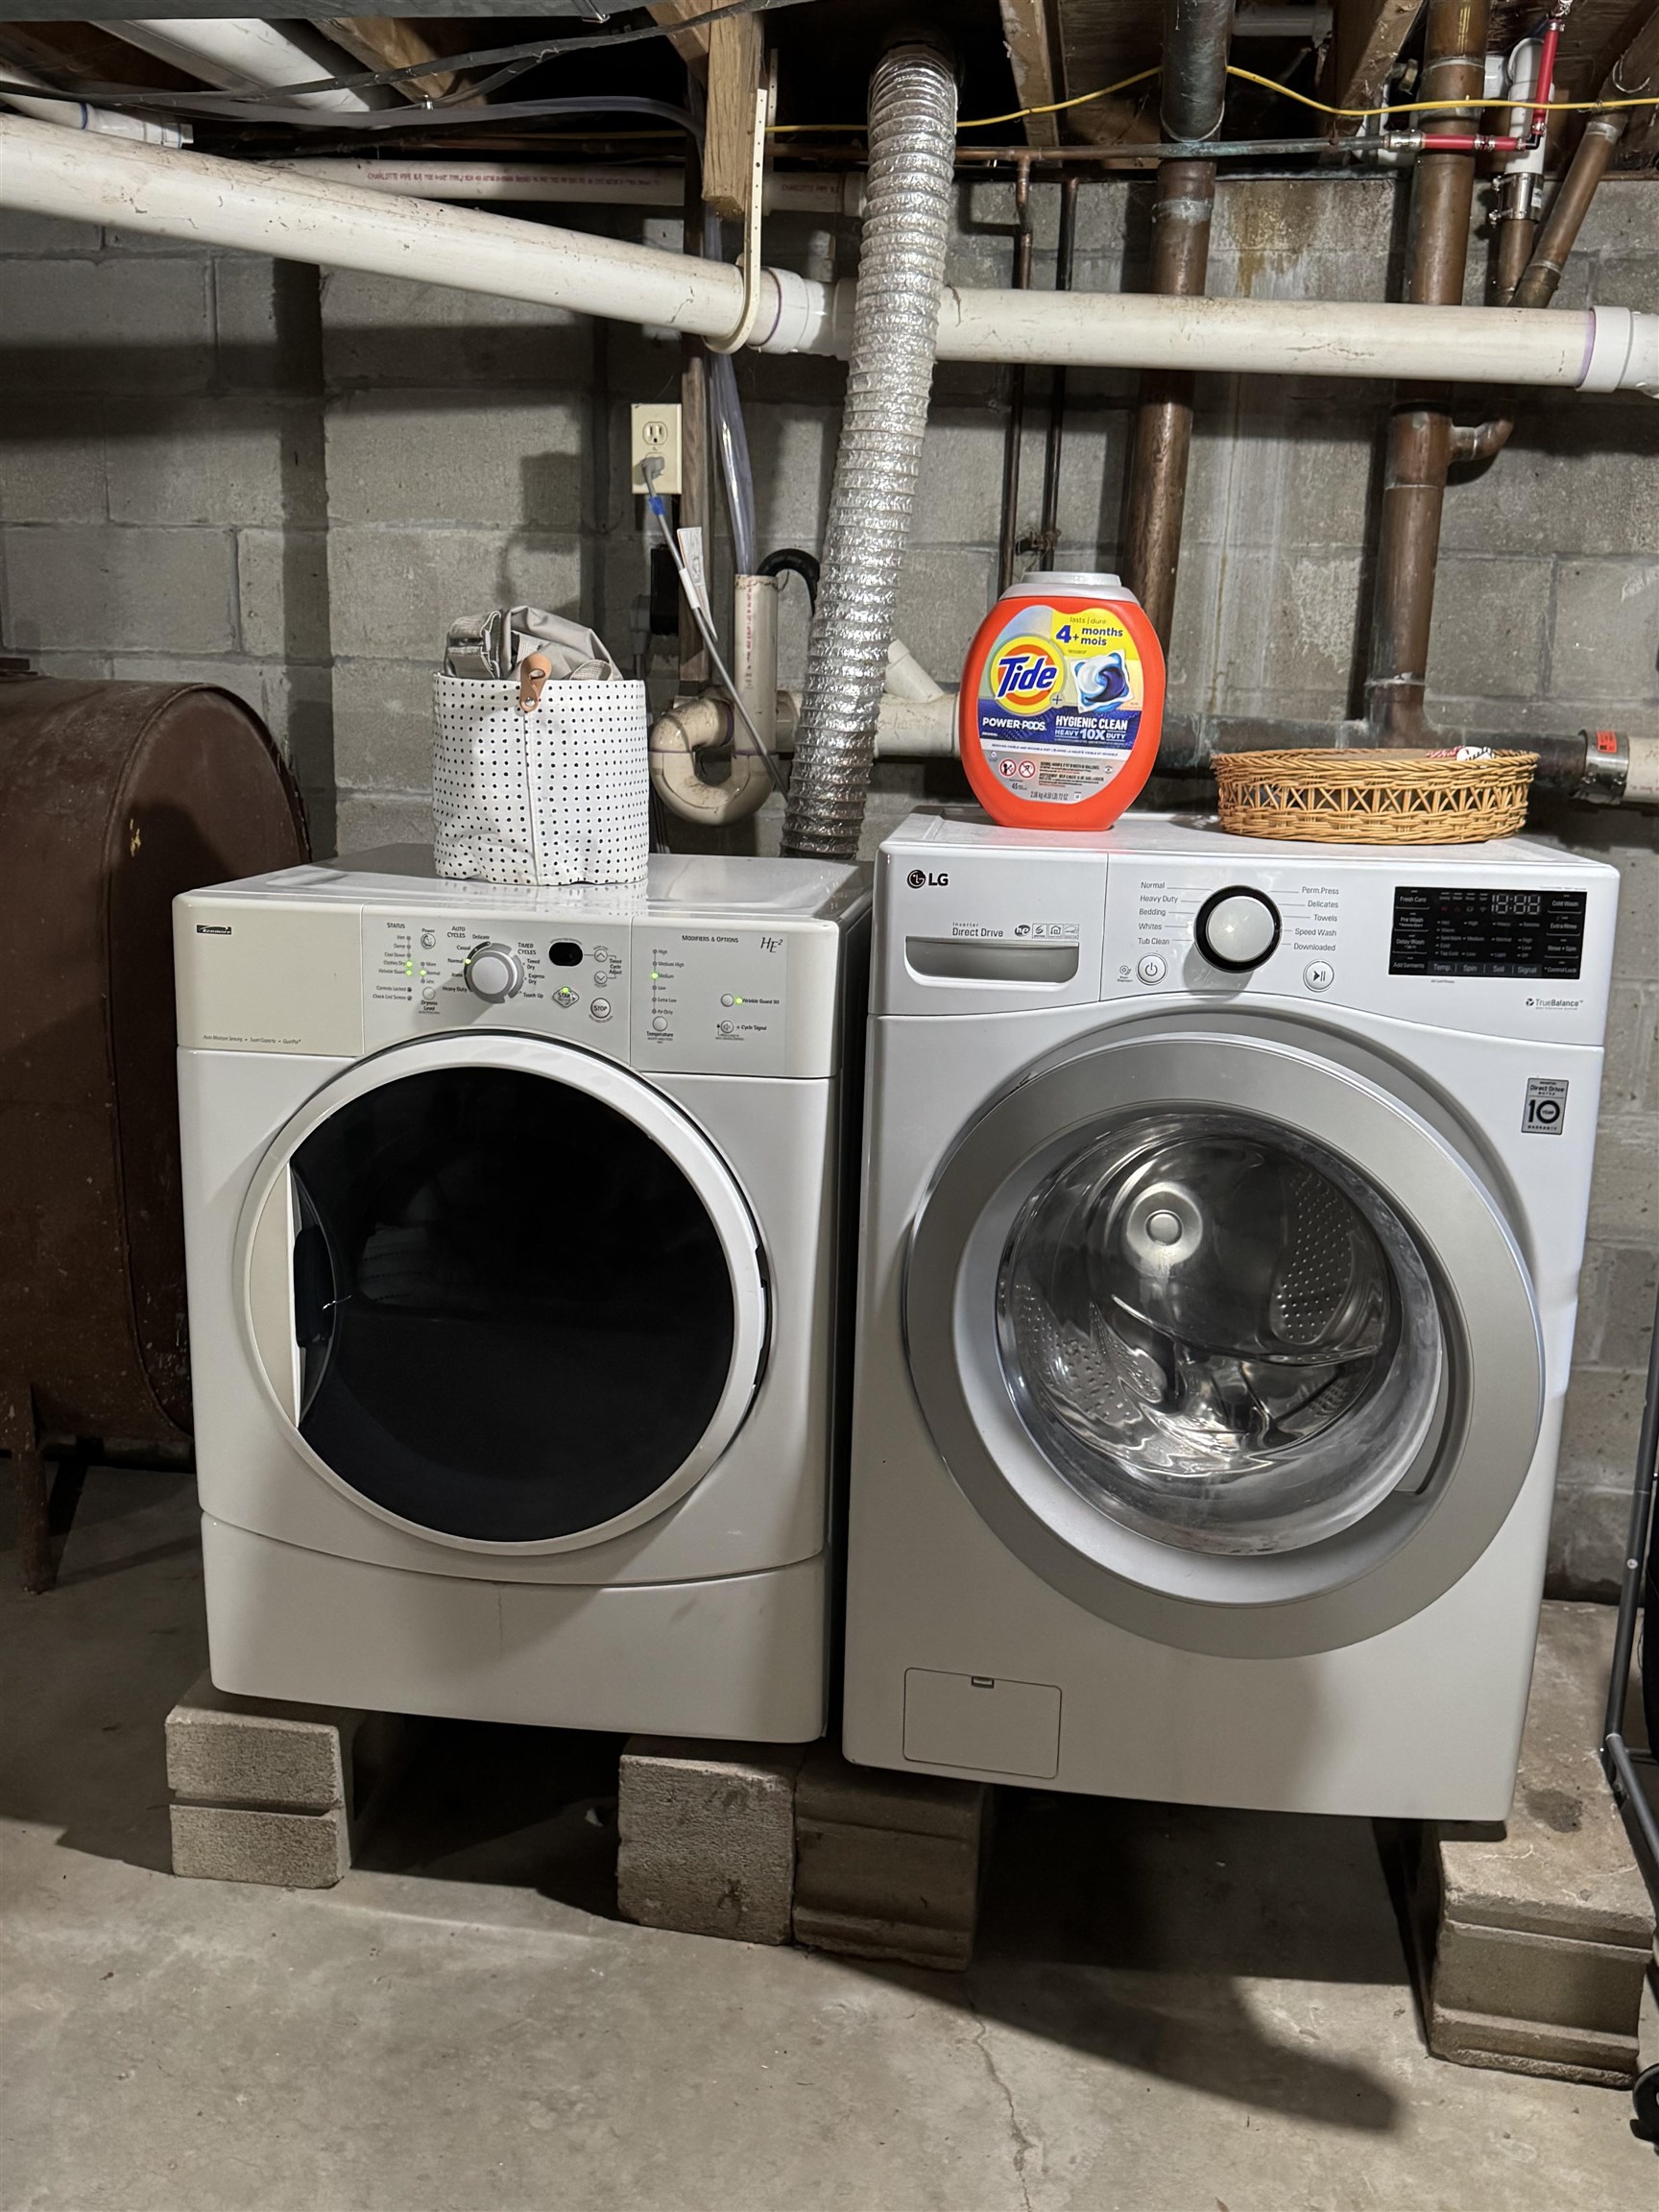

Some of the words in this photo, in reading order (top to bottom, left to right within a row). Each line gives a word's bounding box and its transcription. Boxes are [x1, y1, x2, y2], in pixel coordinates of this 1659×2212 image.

[1082, 627, 1123, 637] months
[1081, 637, 1107, 646] mois
[997, 656, 1058, 698] Tide
[1056, 715, 1097, 729] HYGIENIC
[1098, 718, 1128, 730] CLEAN
[1080, 729, 1106, 741] 10X
[928, 873, 949, 886] LG
[1321, 887, 1339, 895] Press
[1140, 895, 1161, 903] Heavy
[1162, 895, 1178, 903] Duty
[1308, 900, 1339, 908] Delicates
[1139, 908, 1166, 916] Bedding
[1314, 914, 1338, 922] Towels
[952, 927, 979, 937] Direct
[980, 928, 1004, 938] Drive
[1295, 928, 1316, 937] Speed
[1294, 942, 1336, 951] Downloaded
[1517, 966, 1537, 974] Signal
[1528, 1099, 1560, 1124] 10
